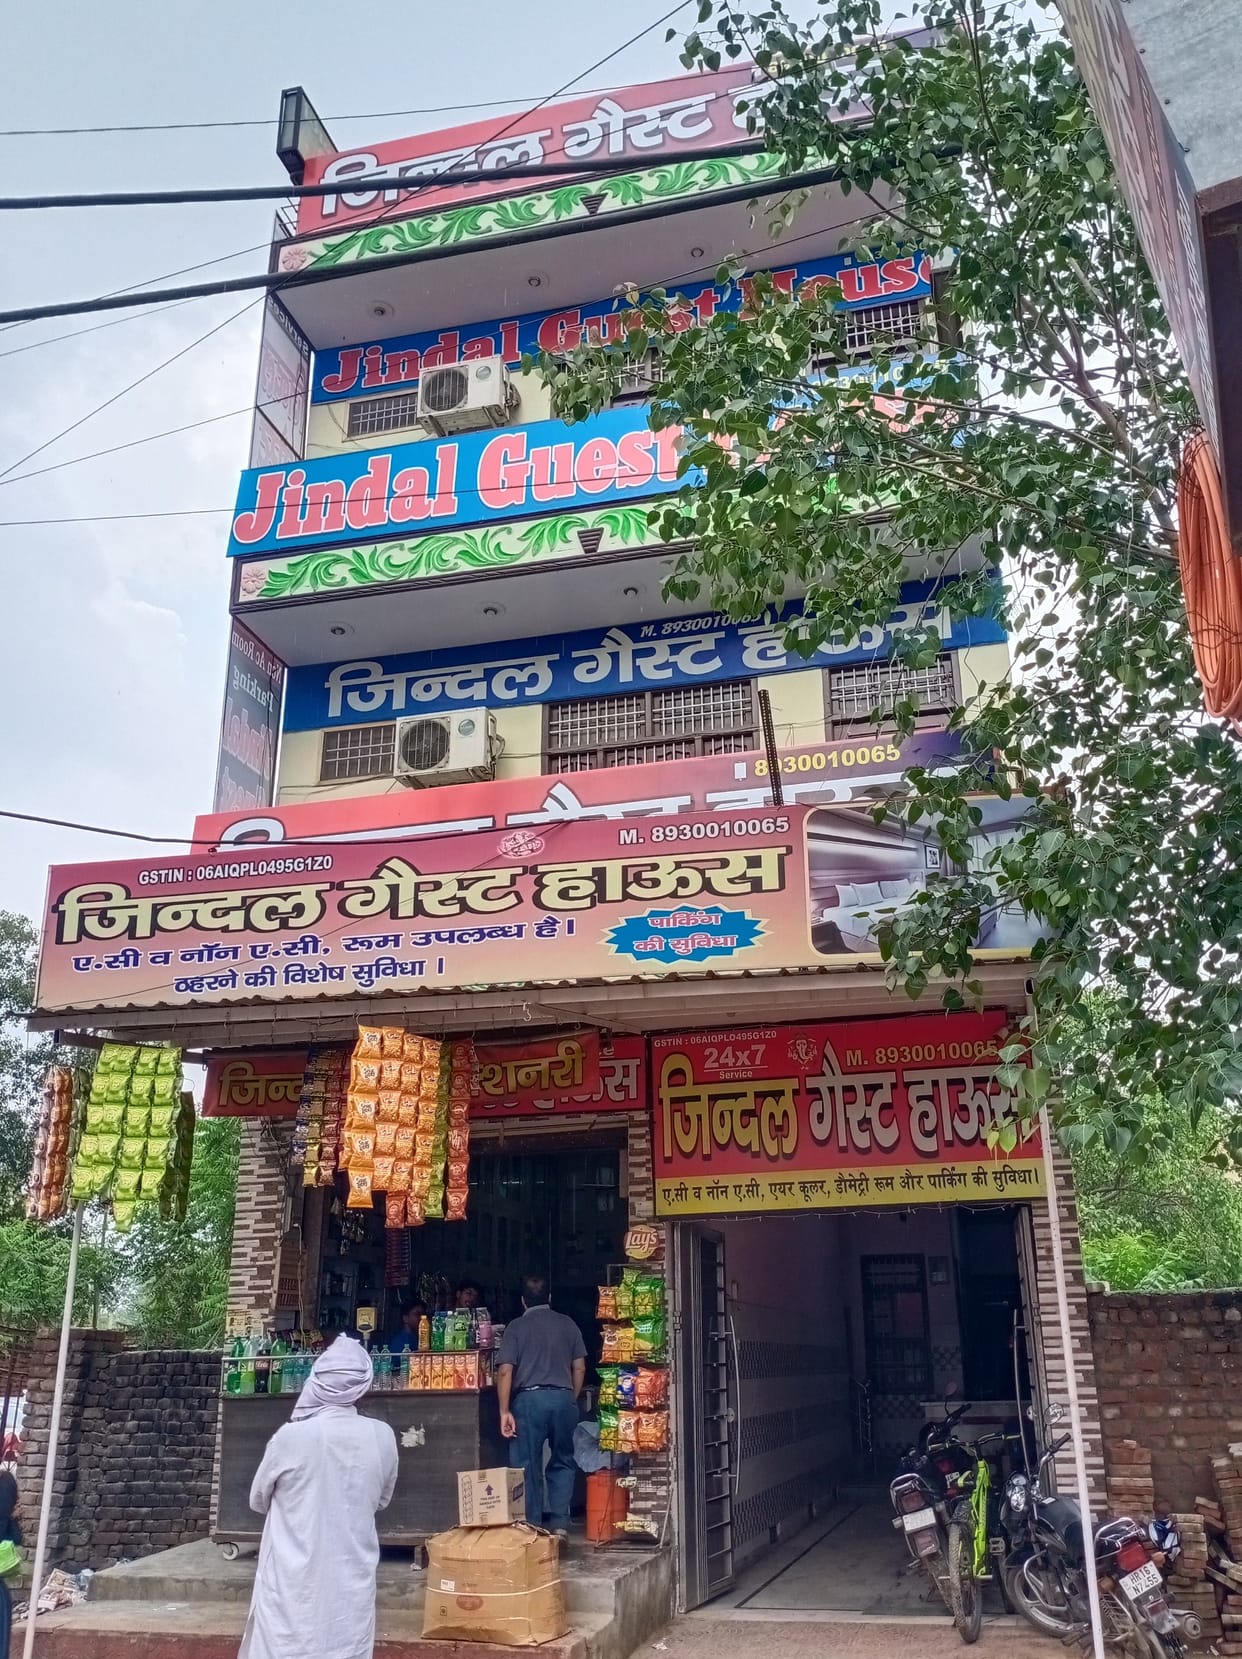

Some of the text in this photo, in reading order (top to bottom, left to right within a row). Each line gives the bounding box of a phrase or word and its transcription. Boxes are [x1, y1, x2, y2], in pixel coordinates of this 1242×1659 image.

[321, 320, 521, 393] Jindal
[232, 443, 458, 544] Jindal
[477, 425, 686, 509] Guest
[324, 654, 559, 717] जिन्दल
[571, 627, 725, 682] गैस्ट
[754, 743, 901, 777] 830010065
[619, 817, 790, 845] M. 8930010065
[139, 868, 184, 885] GSTIN
[54, 846, 790, 944] जिन्दल गैस्ट हाऊस
[150, 951, 172, 966] व
[180, 943, 241, 963] नॉन
[342, 933, 403, 953] रूम
[412, 922, 526, 947] उपलब्ध
[633, 932, 738, 955] की सुविधा
[175, 969, 239, 993] ठहरने
[244, 965, 278, 988] की
[282, 961, 346, 984] विशेष
[352, 957, 426, 988] सुविधा
[654, 1038, 682, 1047] GSTIN
[703, 1044, 766, 1069] 24x7
[846, 1040, 998, 1066] M. 8930010065
[719, 1070, 753, 1079] Service
[658, 1053, 799, 1159] जिन्दल
[805, 1040, 899, 1149] गैस्ट
[693, 1187, 701, 1196] व
[706, 1179, 729, 1200] नॉन
[768, 1181, 794, 1200] एयर
[873, 1176, 894, 1192] रूम
[899, 1169, 924, 1190] और
[971, 1166, 989, 1187] की
